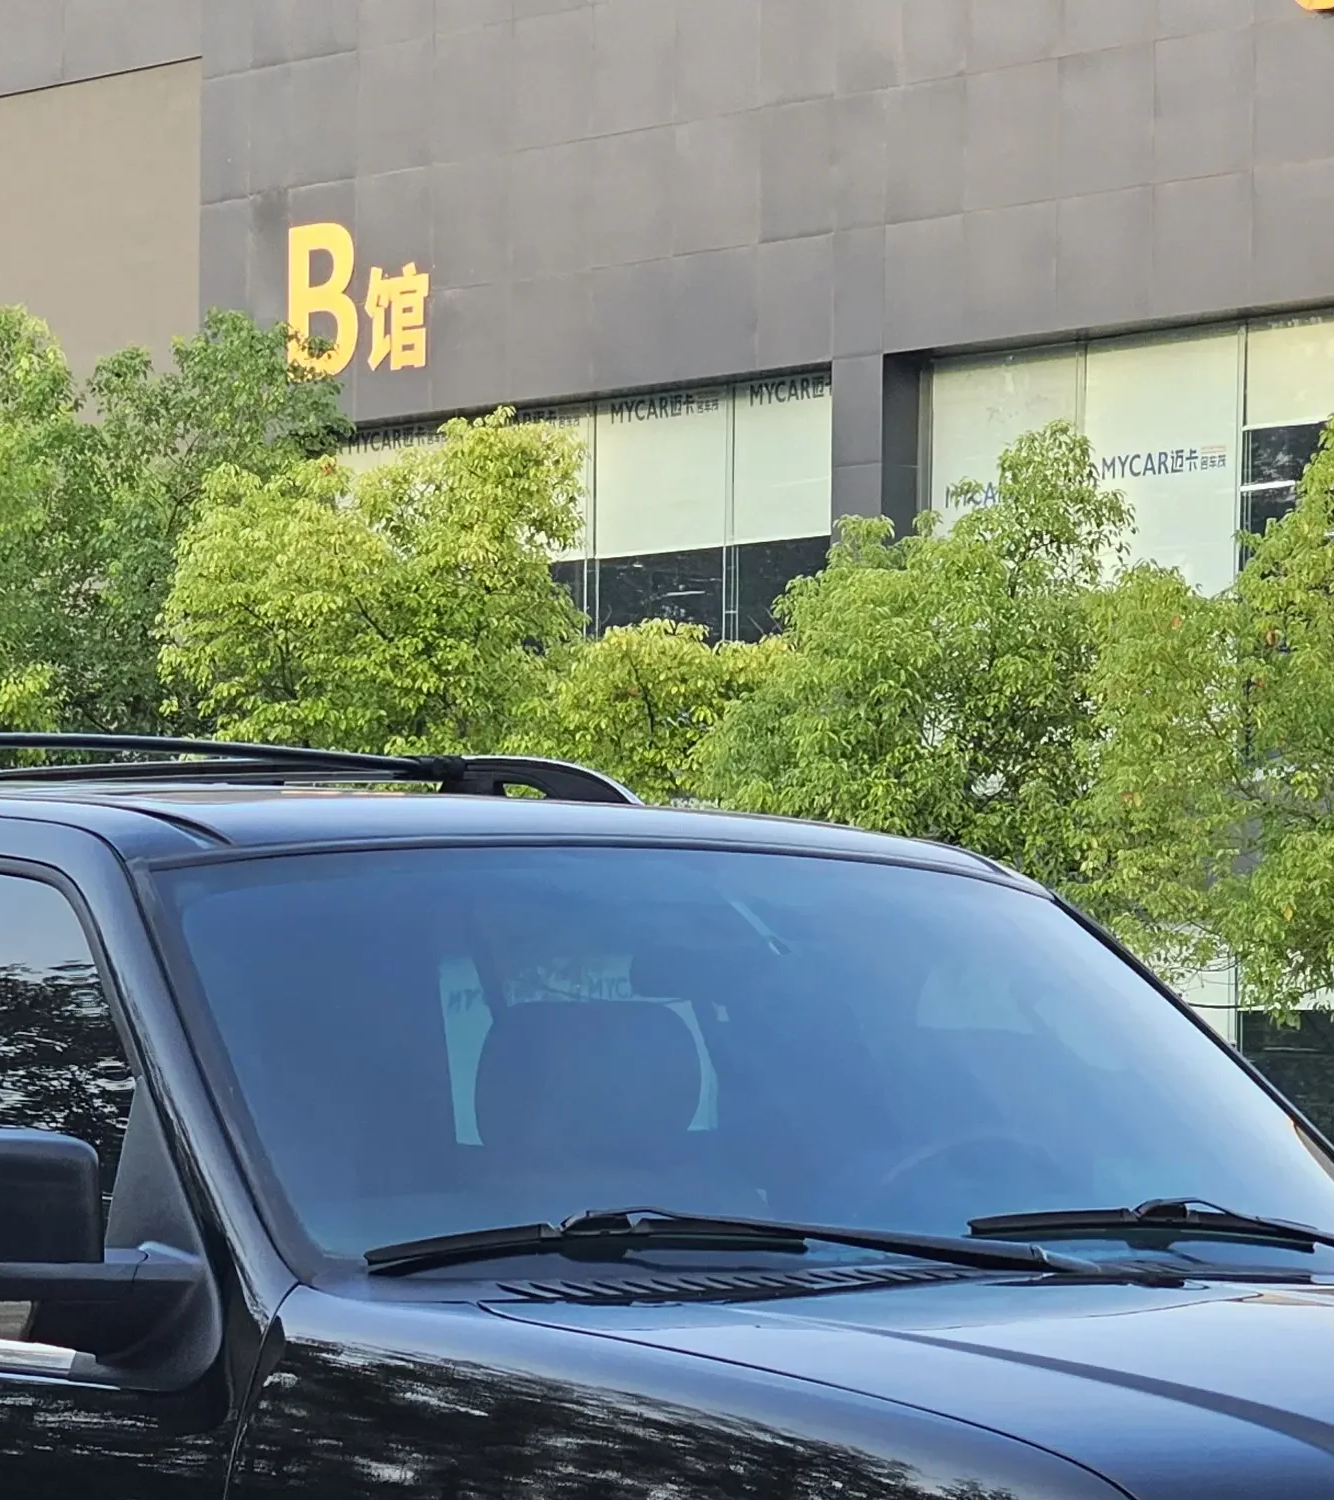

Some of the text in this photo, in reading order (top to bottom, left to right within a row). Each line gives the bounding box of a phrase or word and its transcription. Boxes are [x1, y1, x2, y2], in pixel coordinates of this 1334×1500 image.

[750, 378, 811, 407] MYCAR
[610, 396, 669, 425] MYCAR
[1101, 451, 1169, 480] MYCAR
